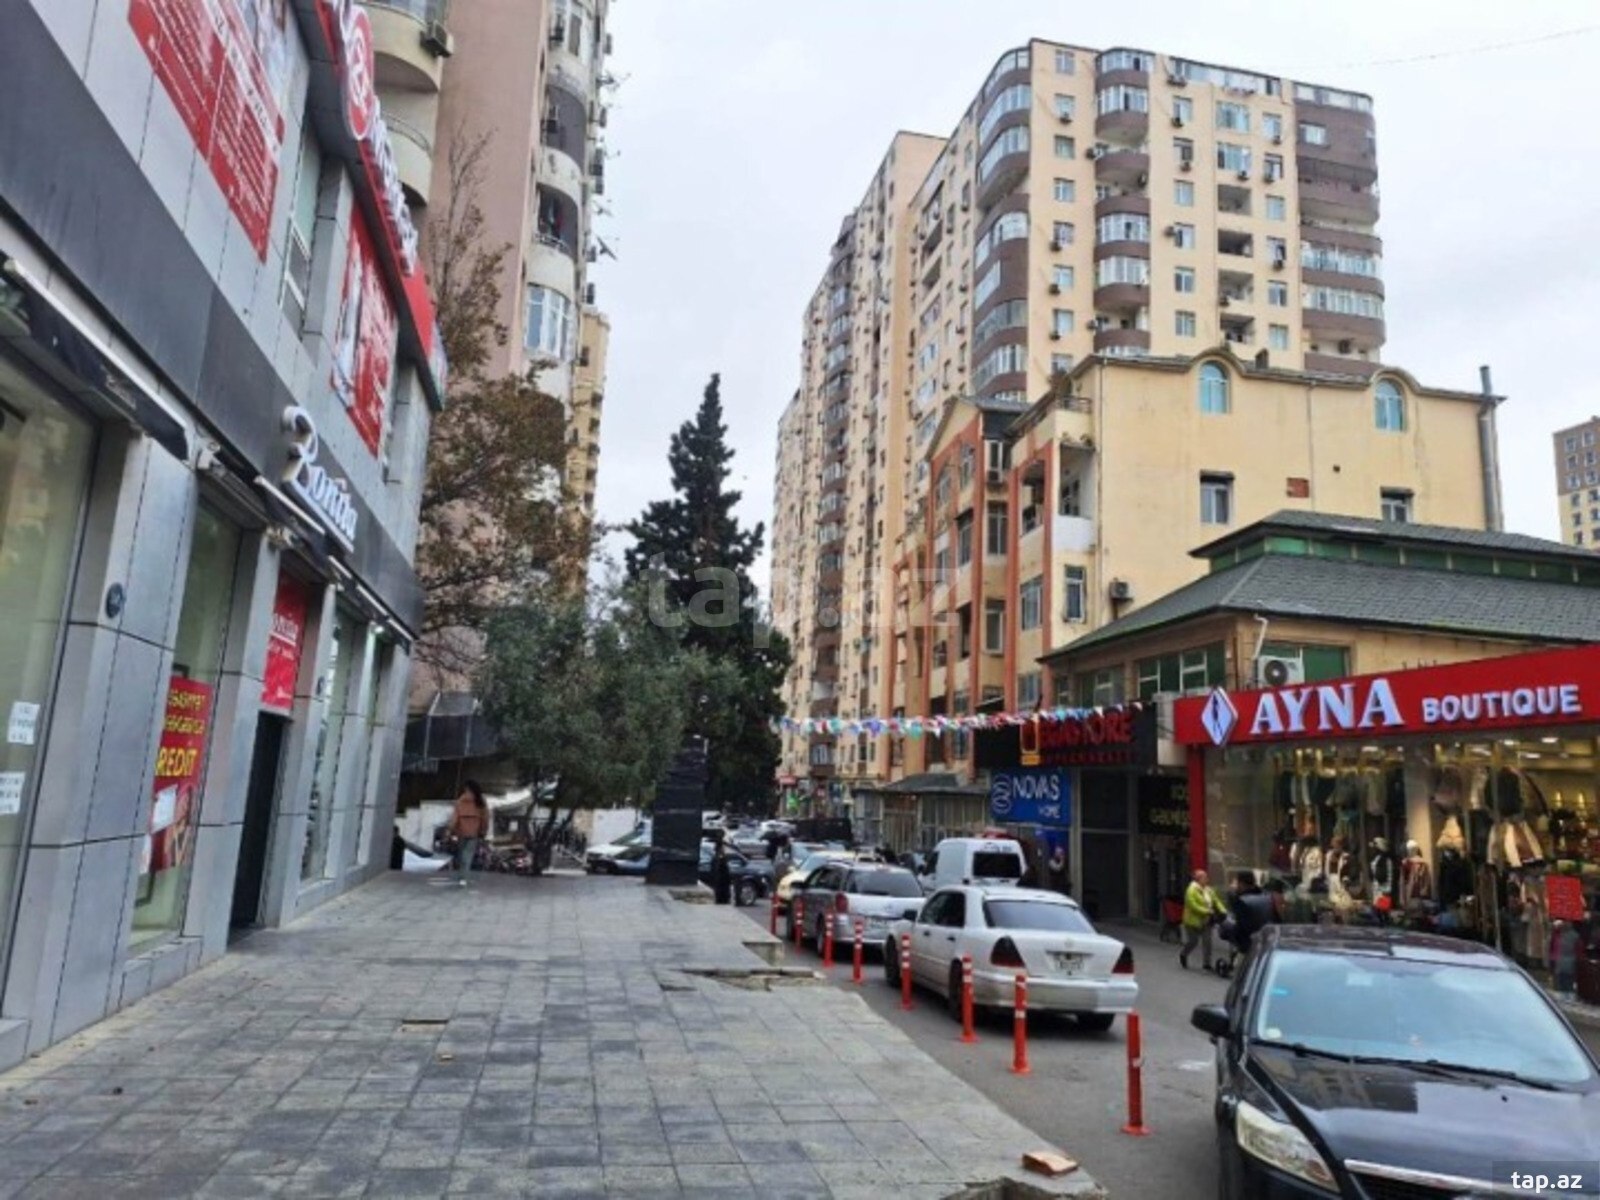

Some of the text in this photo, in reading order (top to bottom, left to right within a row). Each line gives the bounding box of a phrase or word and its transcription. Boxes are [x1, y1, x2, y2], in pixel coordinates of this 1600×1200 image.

[1250, 677, 1582, 736] AYNA BOUTIQUE
[1013, 774, 1060, 800] NOVAS
